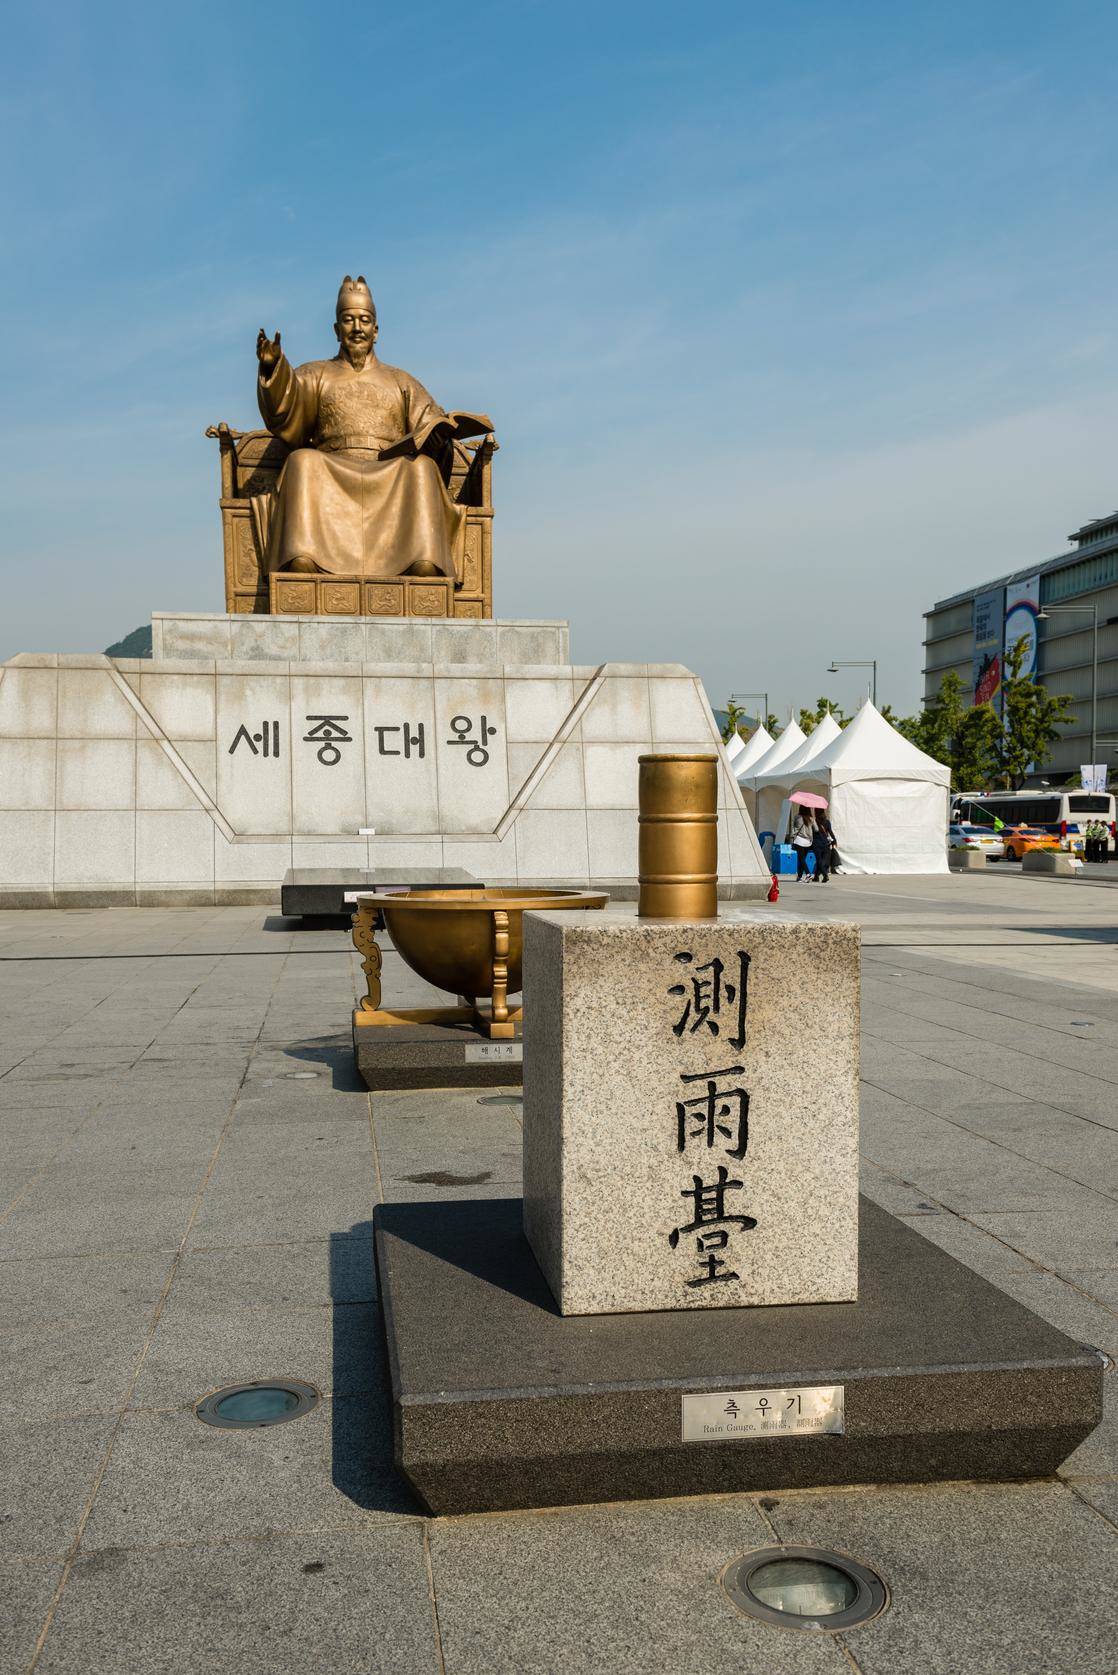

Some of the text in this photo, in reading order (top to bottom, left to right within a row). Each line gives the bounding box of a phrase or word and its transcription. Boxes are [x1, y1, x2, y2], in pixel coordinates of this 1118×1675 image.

[228, 715, 497, 767] 세종대왕
[723, 1394, 801, 1419] 측우기
[703, 1424, 723, 1433] Rain
